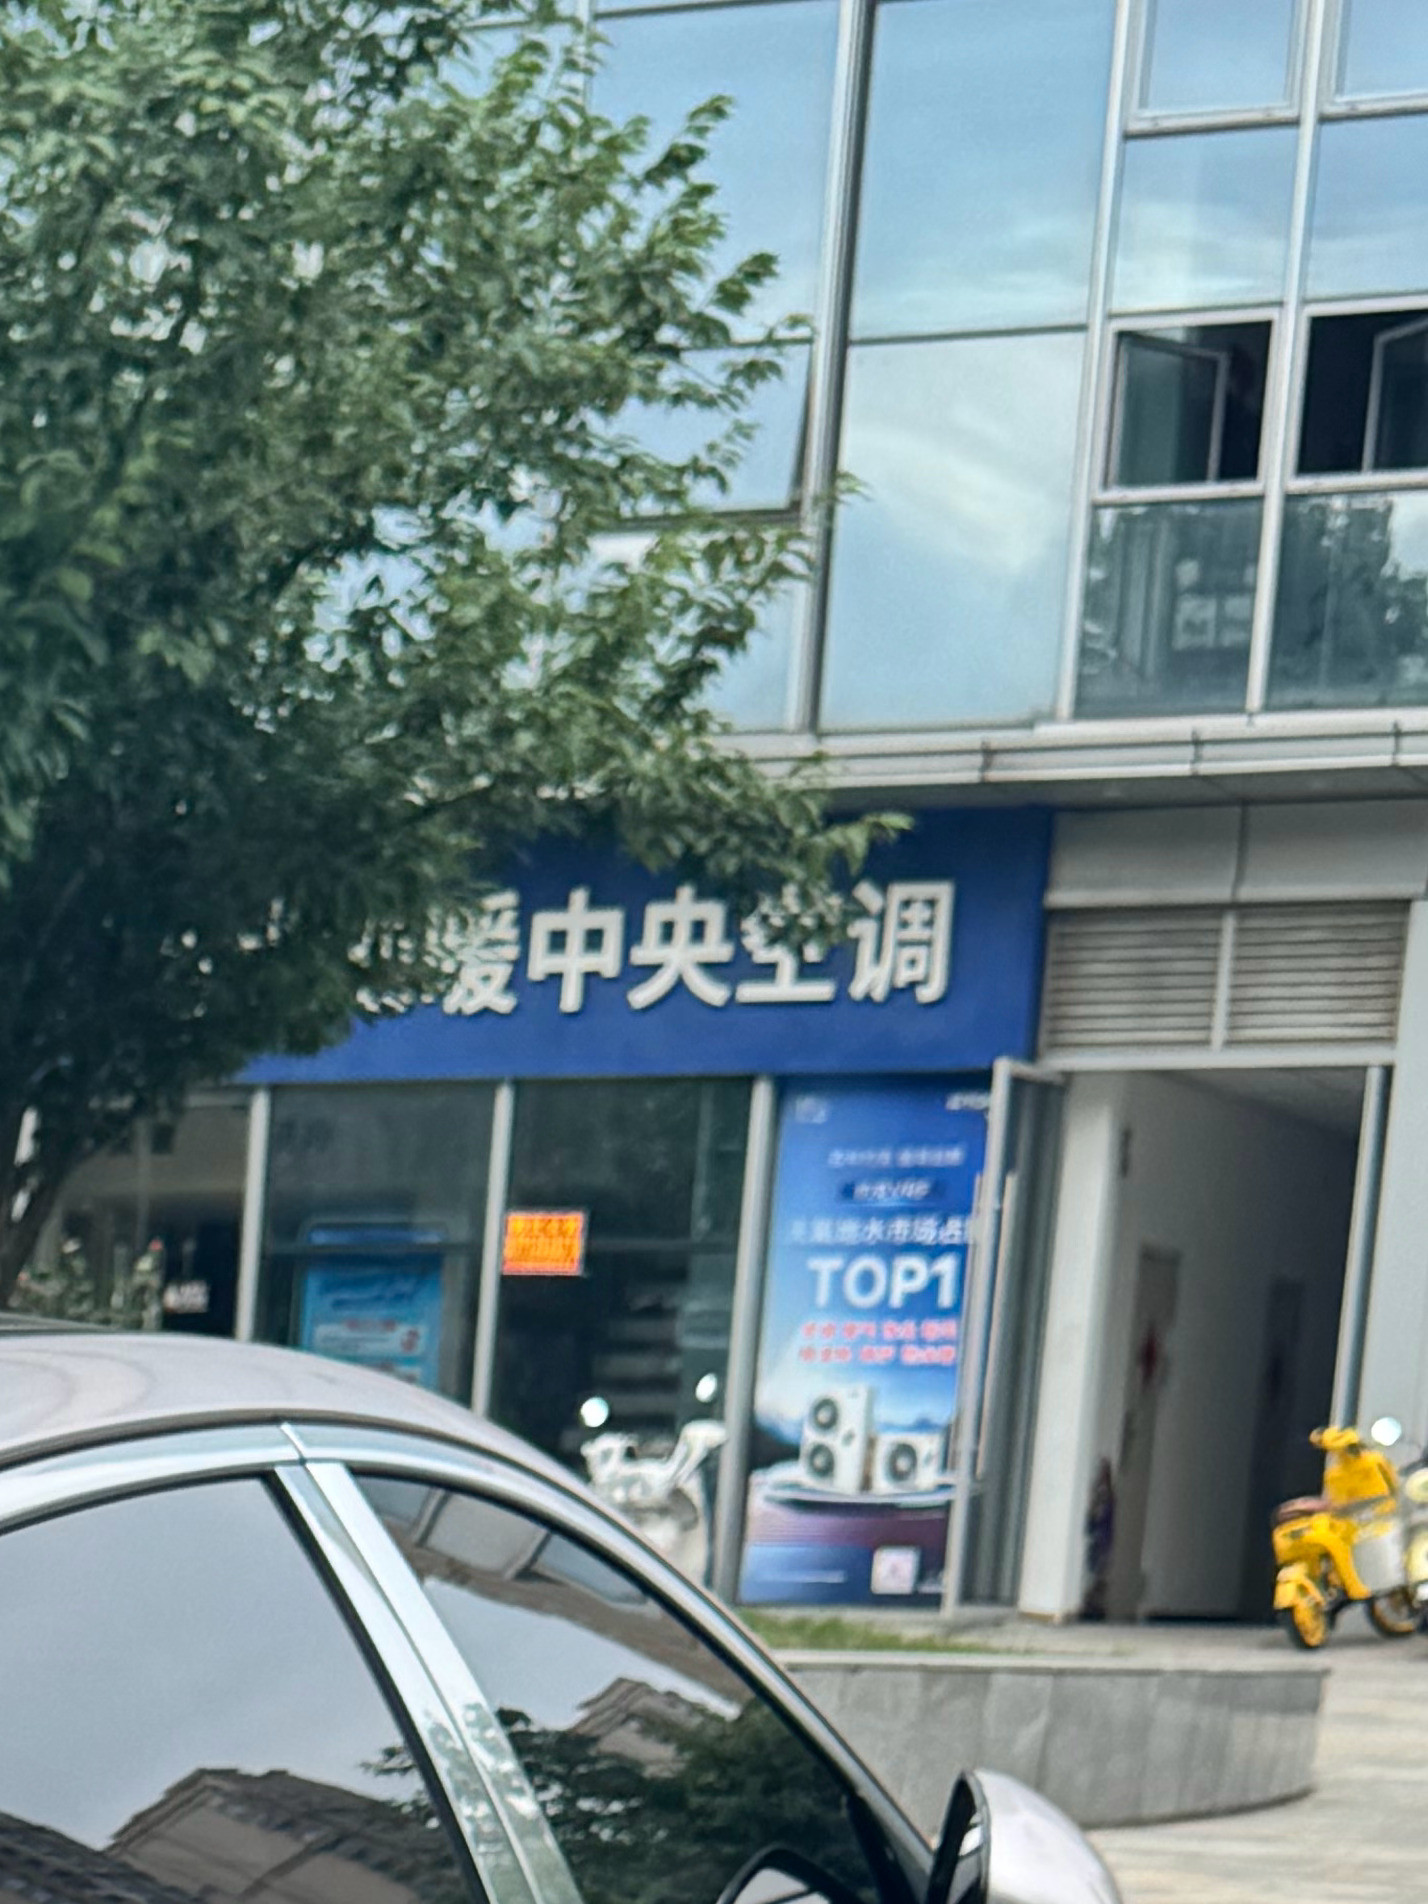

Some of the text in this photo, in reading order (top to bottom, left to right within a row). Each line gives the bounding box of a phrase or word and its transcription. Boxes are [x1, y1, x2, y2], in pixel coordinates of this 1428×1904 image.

[348, 879, 955, 1014] 暖中央空调
[806, 1253, 959, 1309] TOP1
